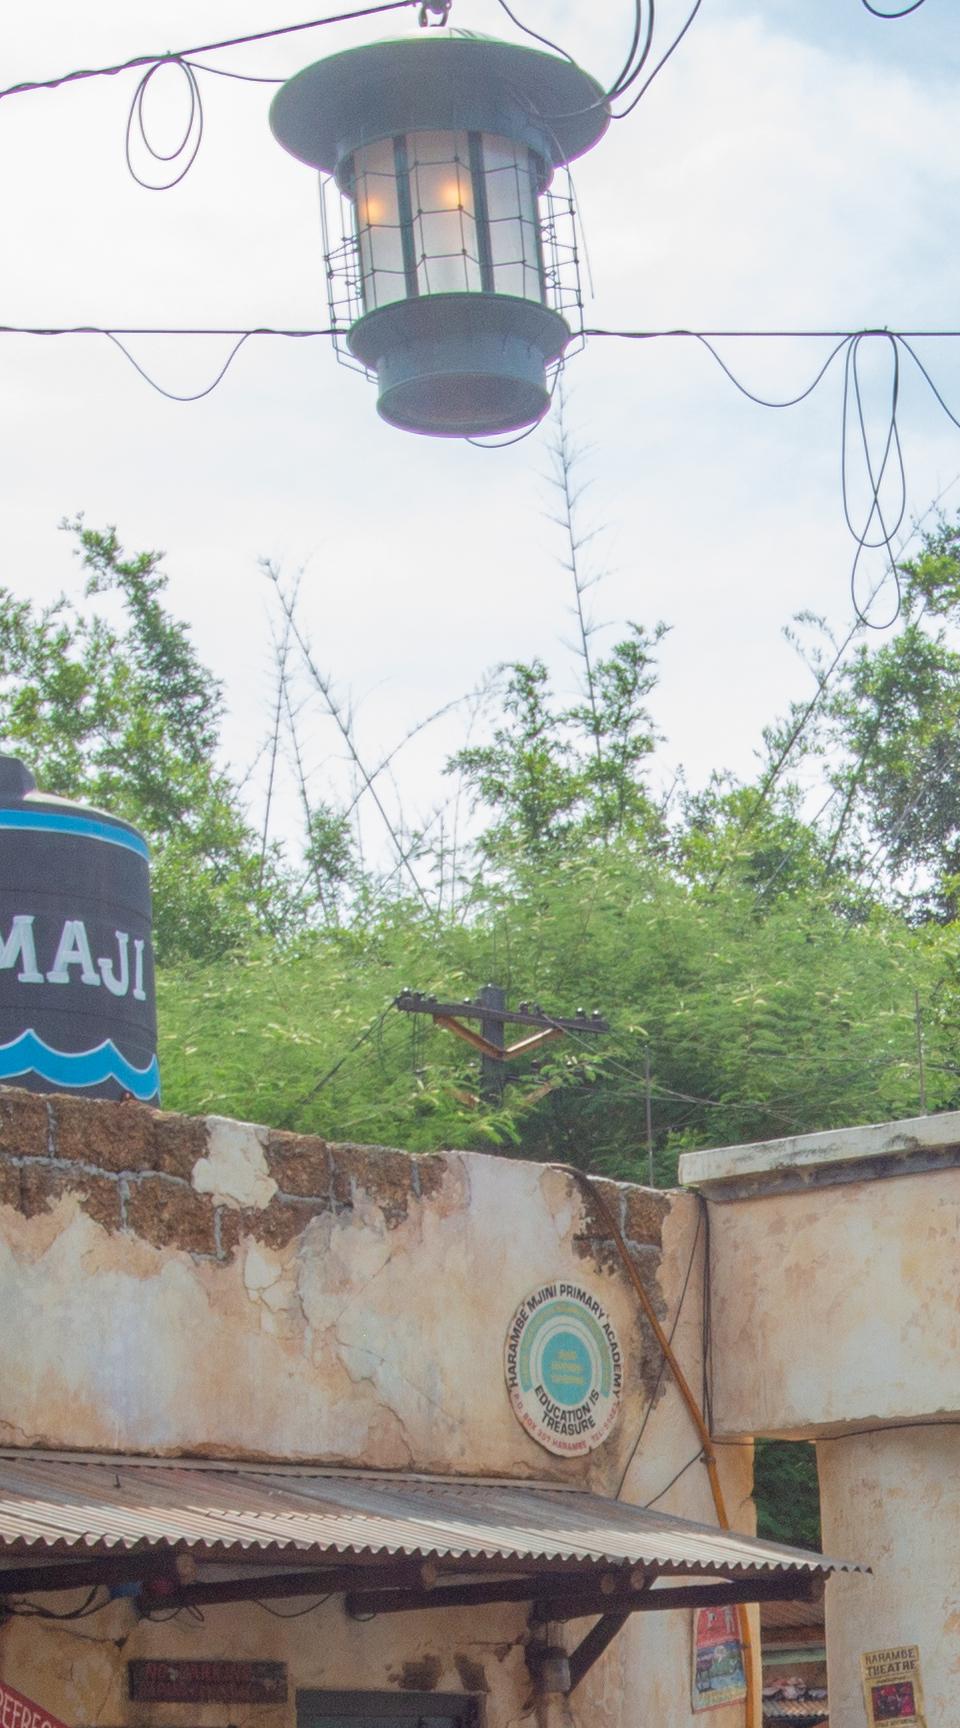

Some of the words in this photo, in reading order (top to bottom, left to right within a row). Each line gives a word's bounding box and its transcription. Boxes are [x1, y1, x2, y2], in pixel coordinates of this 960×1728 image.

[0, 914, 146, 1001] MAJI
[507, 1306, 530, 1388] HARAMBE
[527, 1285, 558, 1311] MJINI
[559, 1284, 605, 1320] PRIMARY
[602, 1322, 622, 1399] ACADEMY
[534, 1384, 591, 1424] EDUCATION
[591, 1388, 600, 1407] IS
[541, 1410, 597, 1436] TREASURE
[865, 1648, 916, 1665] HARAMBE
[866, 1660, 918, 1677] THEATRE
